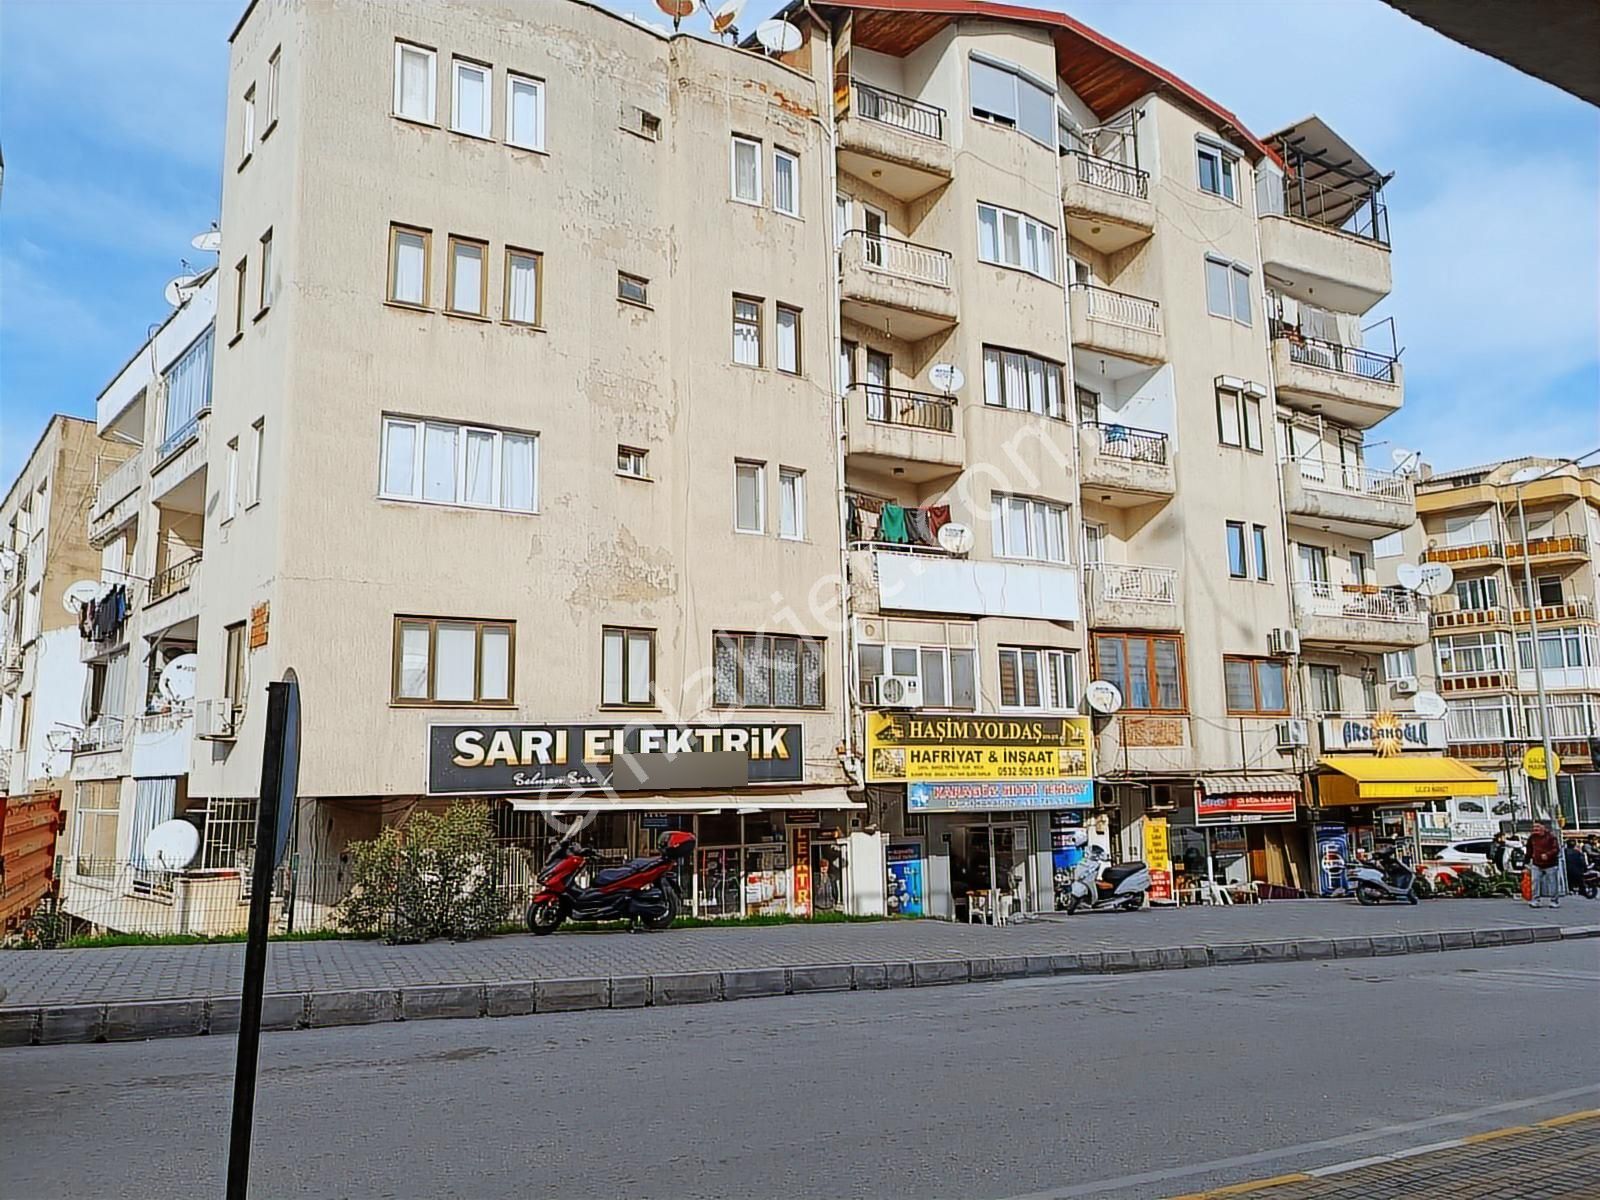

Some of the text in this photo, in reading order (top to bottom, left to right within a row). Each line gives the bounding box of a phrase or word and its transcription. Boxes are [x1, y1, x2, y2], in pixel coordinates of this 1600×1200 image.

[909, 718, 1043, 744] HAŞİM YOLDAŞ
[452, 729, 568, 767] SARI
[910, 747, 1054, 766] HAFRİYAT & İNŞAAT
